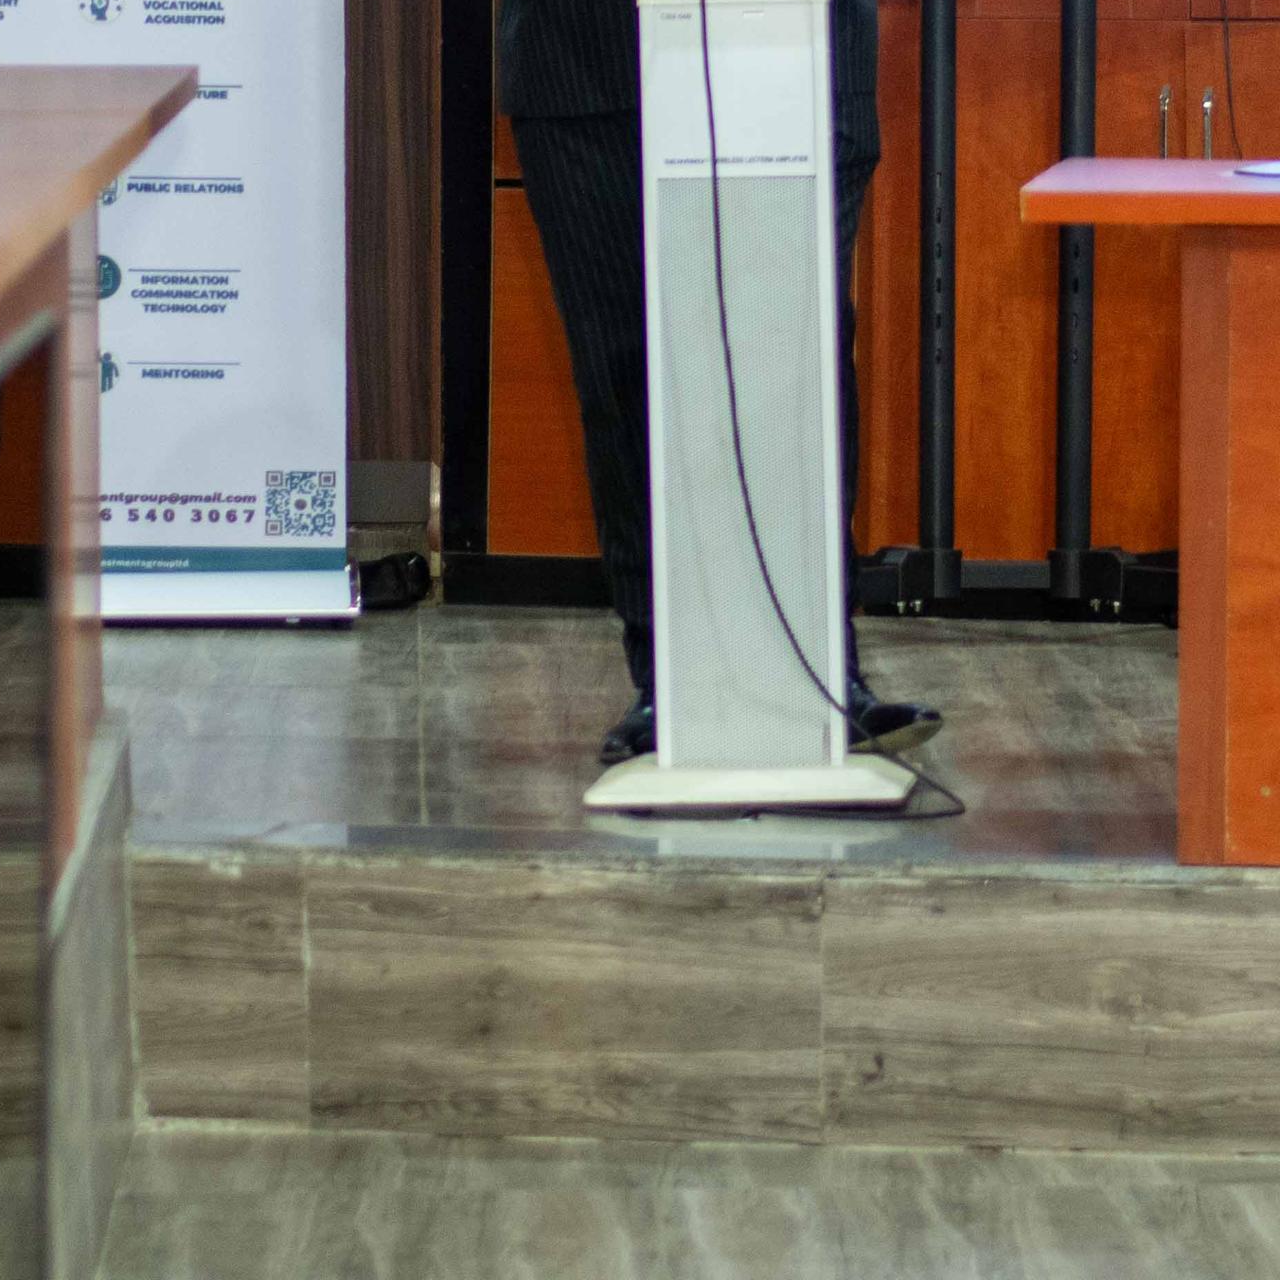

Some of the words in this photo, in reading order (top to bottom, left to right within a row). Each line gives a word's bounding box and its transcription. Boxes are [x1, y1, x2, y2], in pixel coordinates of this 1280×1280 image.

[144, 0, 223, 11] VOCATIONAL
[145, 15, 225, 25] ACQUISITION
[127, 183, 170, 192] PUBLIC
[174, 184, 244, 193] RELATIONS
[141, 276, 229, 285] INFORMATION
[131, 290, 238, 299] COMMUNICATION
[143, 304, 226, 313] TECHNOLOGY
[142, 370, 224, 379] MENTORING
